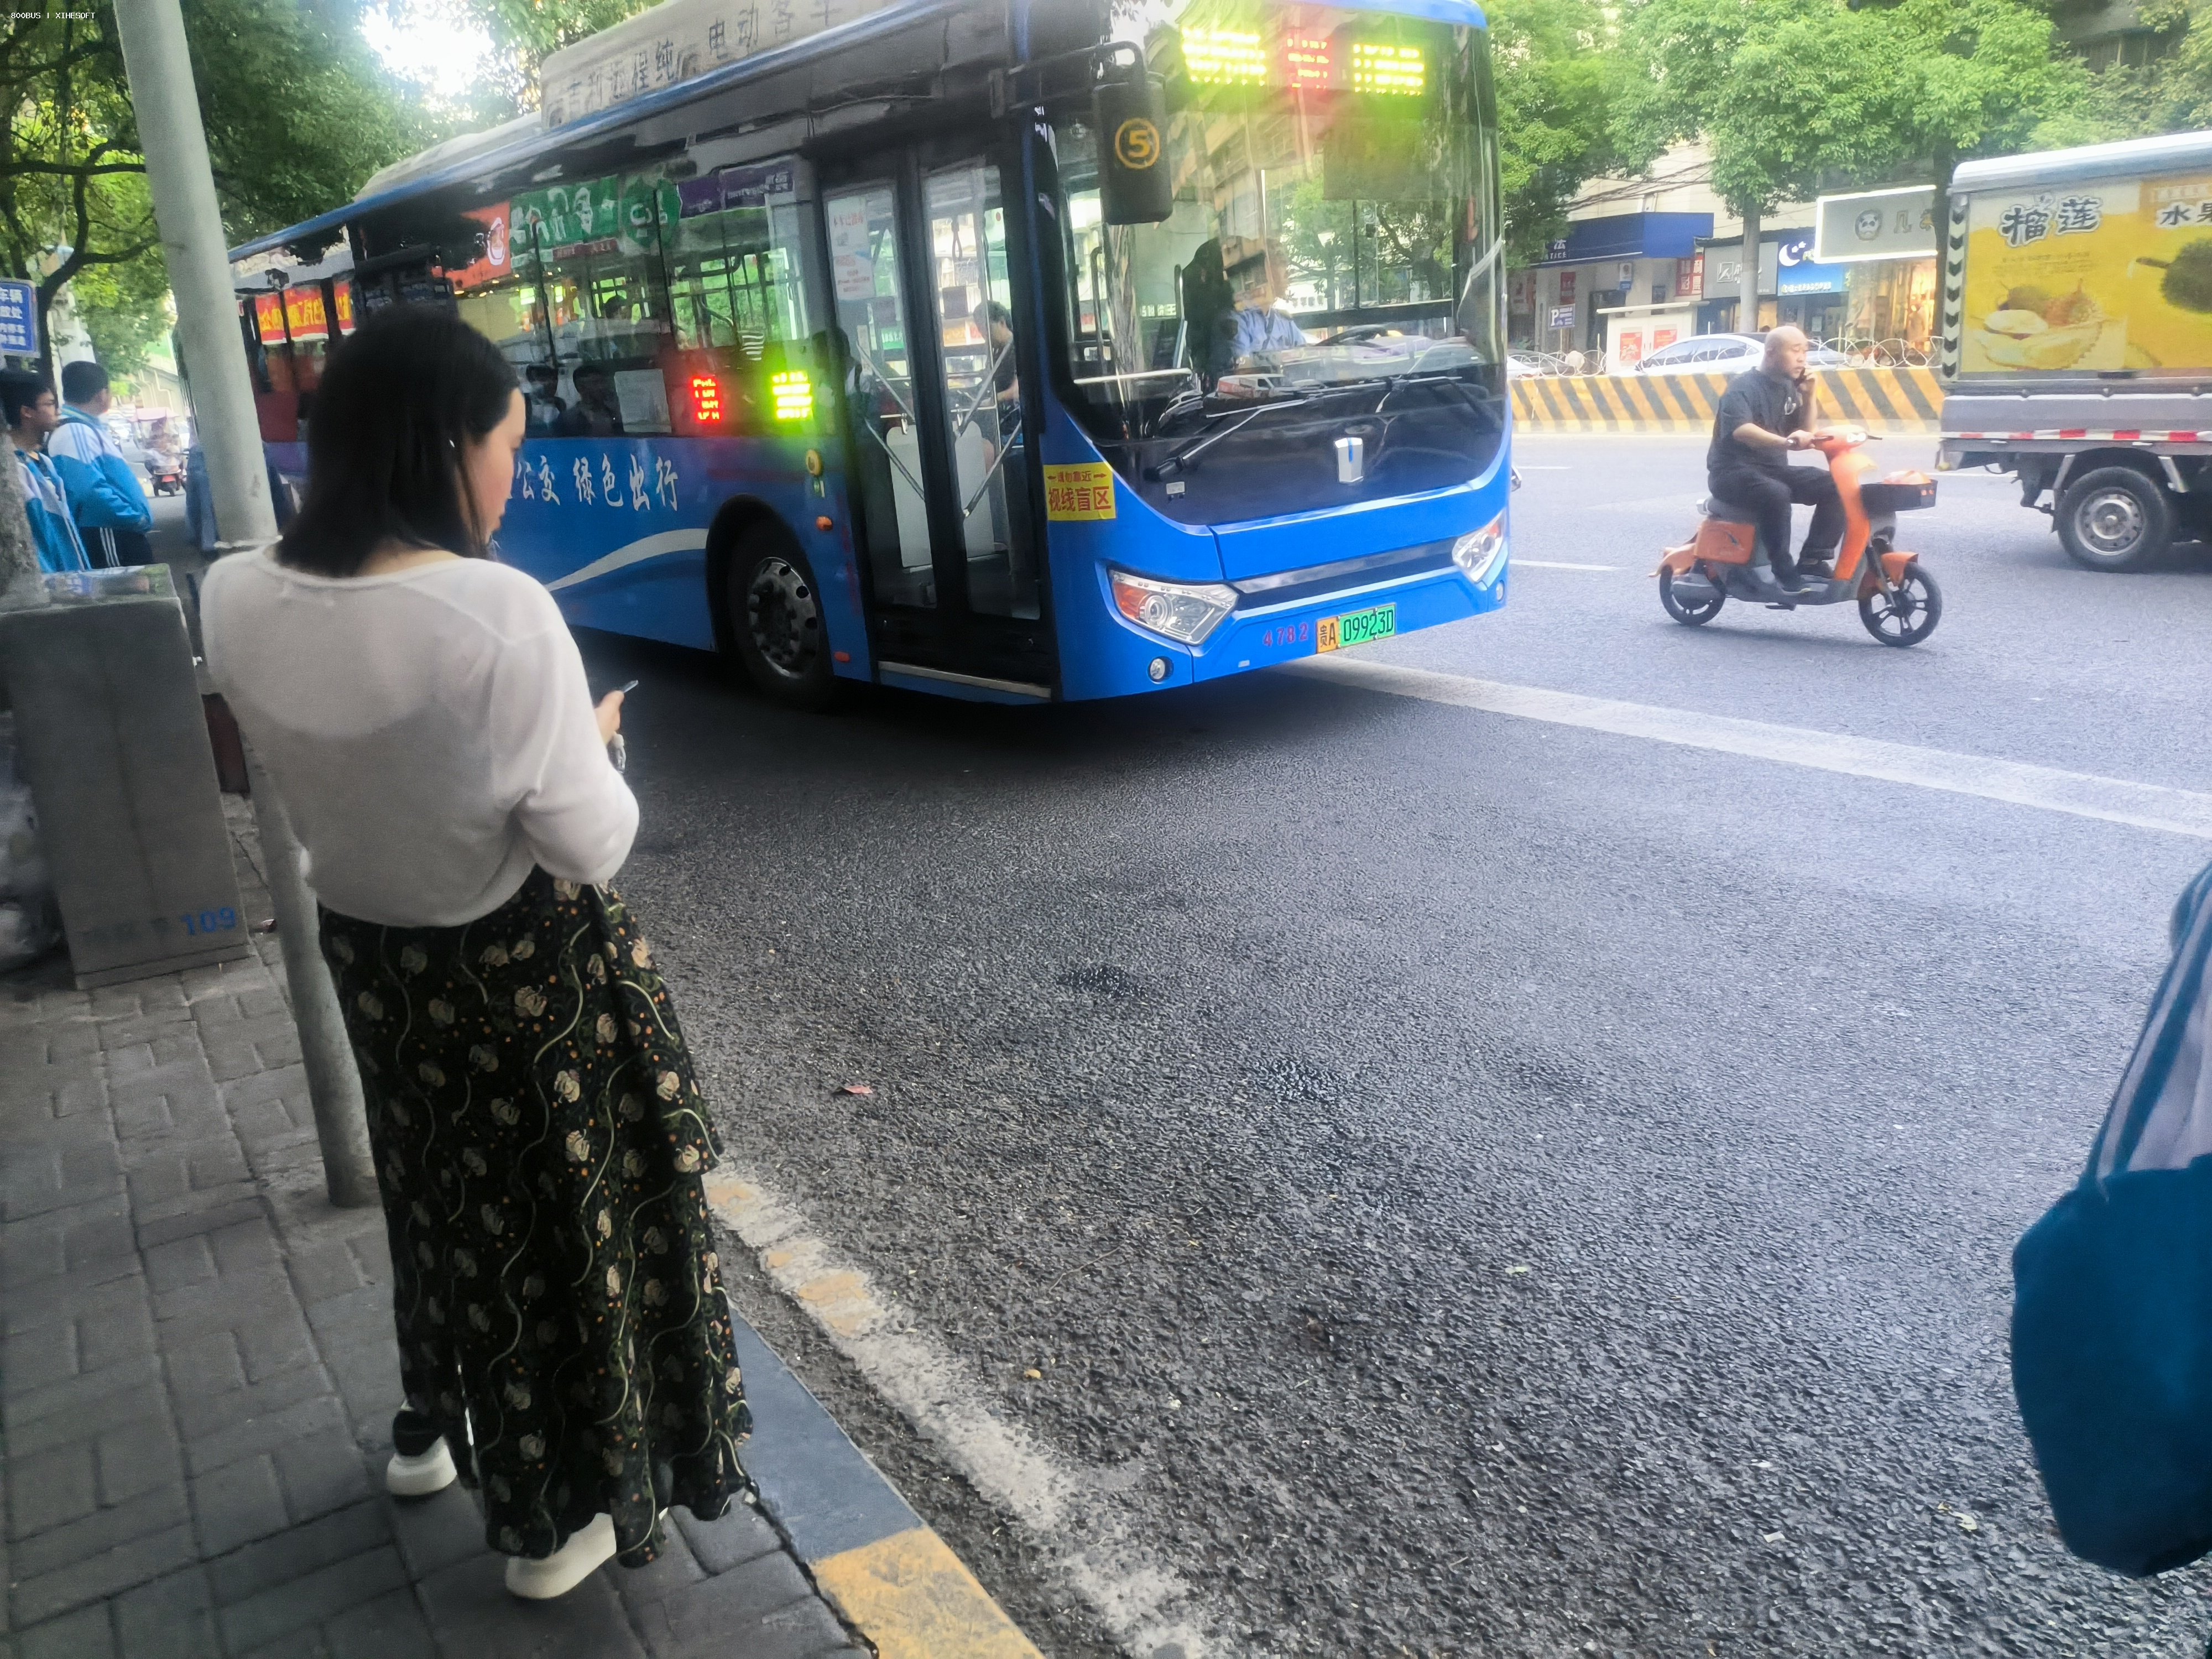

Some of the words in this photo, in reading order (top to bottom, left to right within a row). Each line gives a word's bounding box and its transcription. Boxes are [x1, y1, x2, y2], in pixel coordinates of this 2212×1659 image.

[1128, 129, 1150, 158] 5
[2002, 198, 2098, 245] 榴莲
[1551, 309, 1559, 326] P
[1048, 486, 1112, 512] 视线盲区
[1263, 623, 1308, 647] 4782
[1319, 623, 1337, 648] 贵A
[1344, 609, 1394, 642] 09923D
[181, 907, 235, 936] 109
